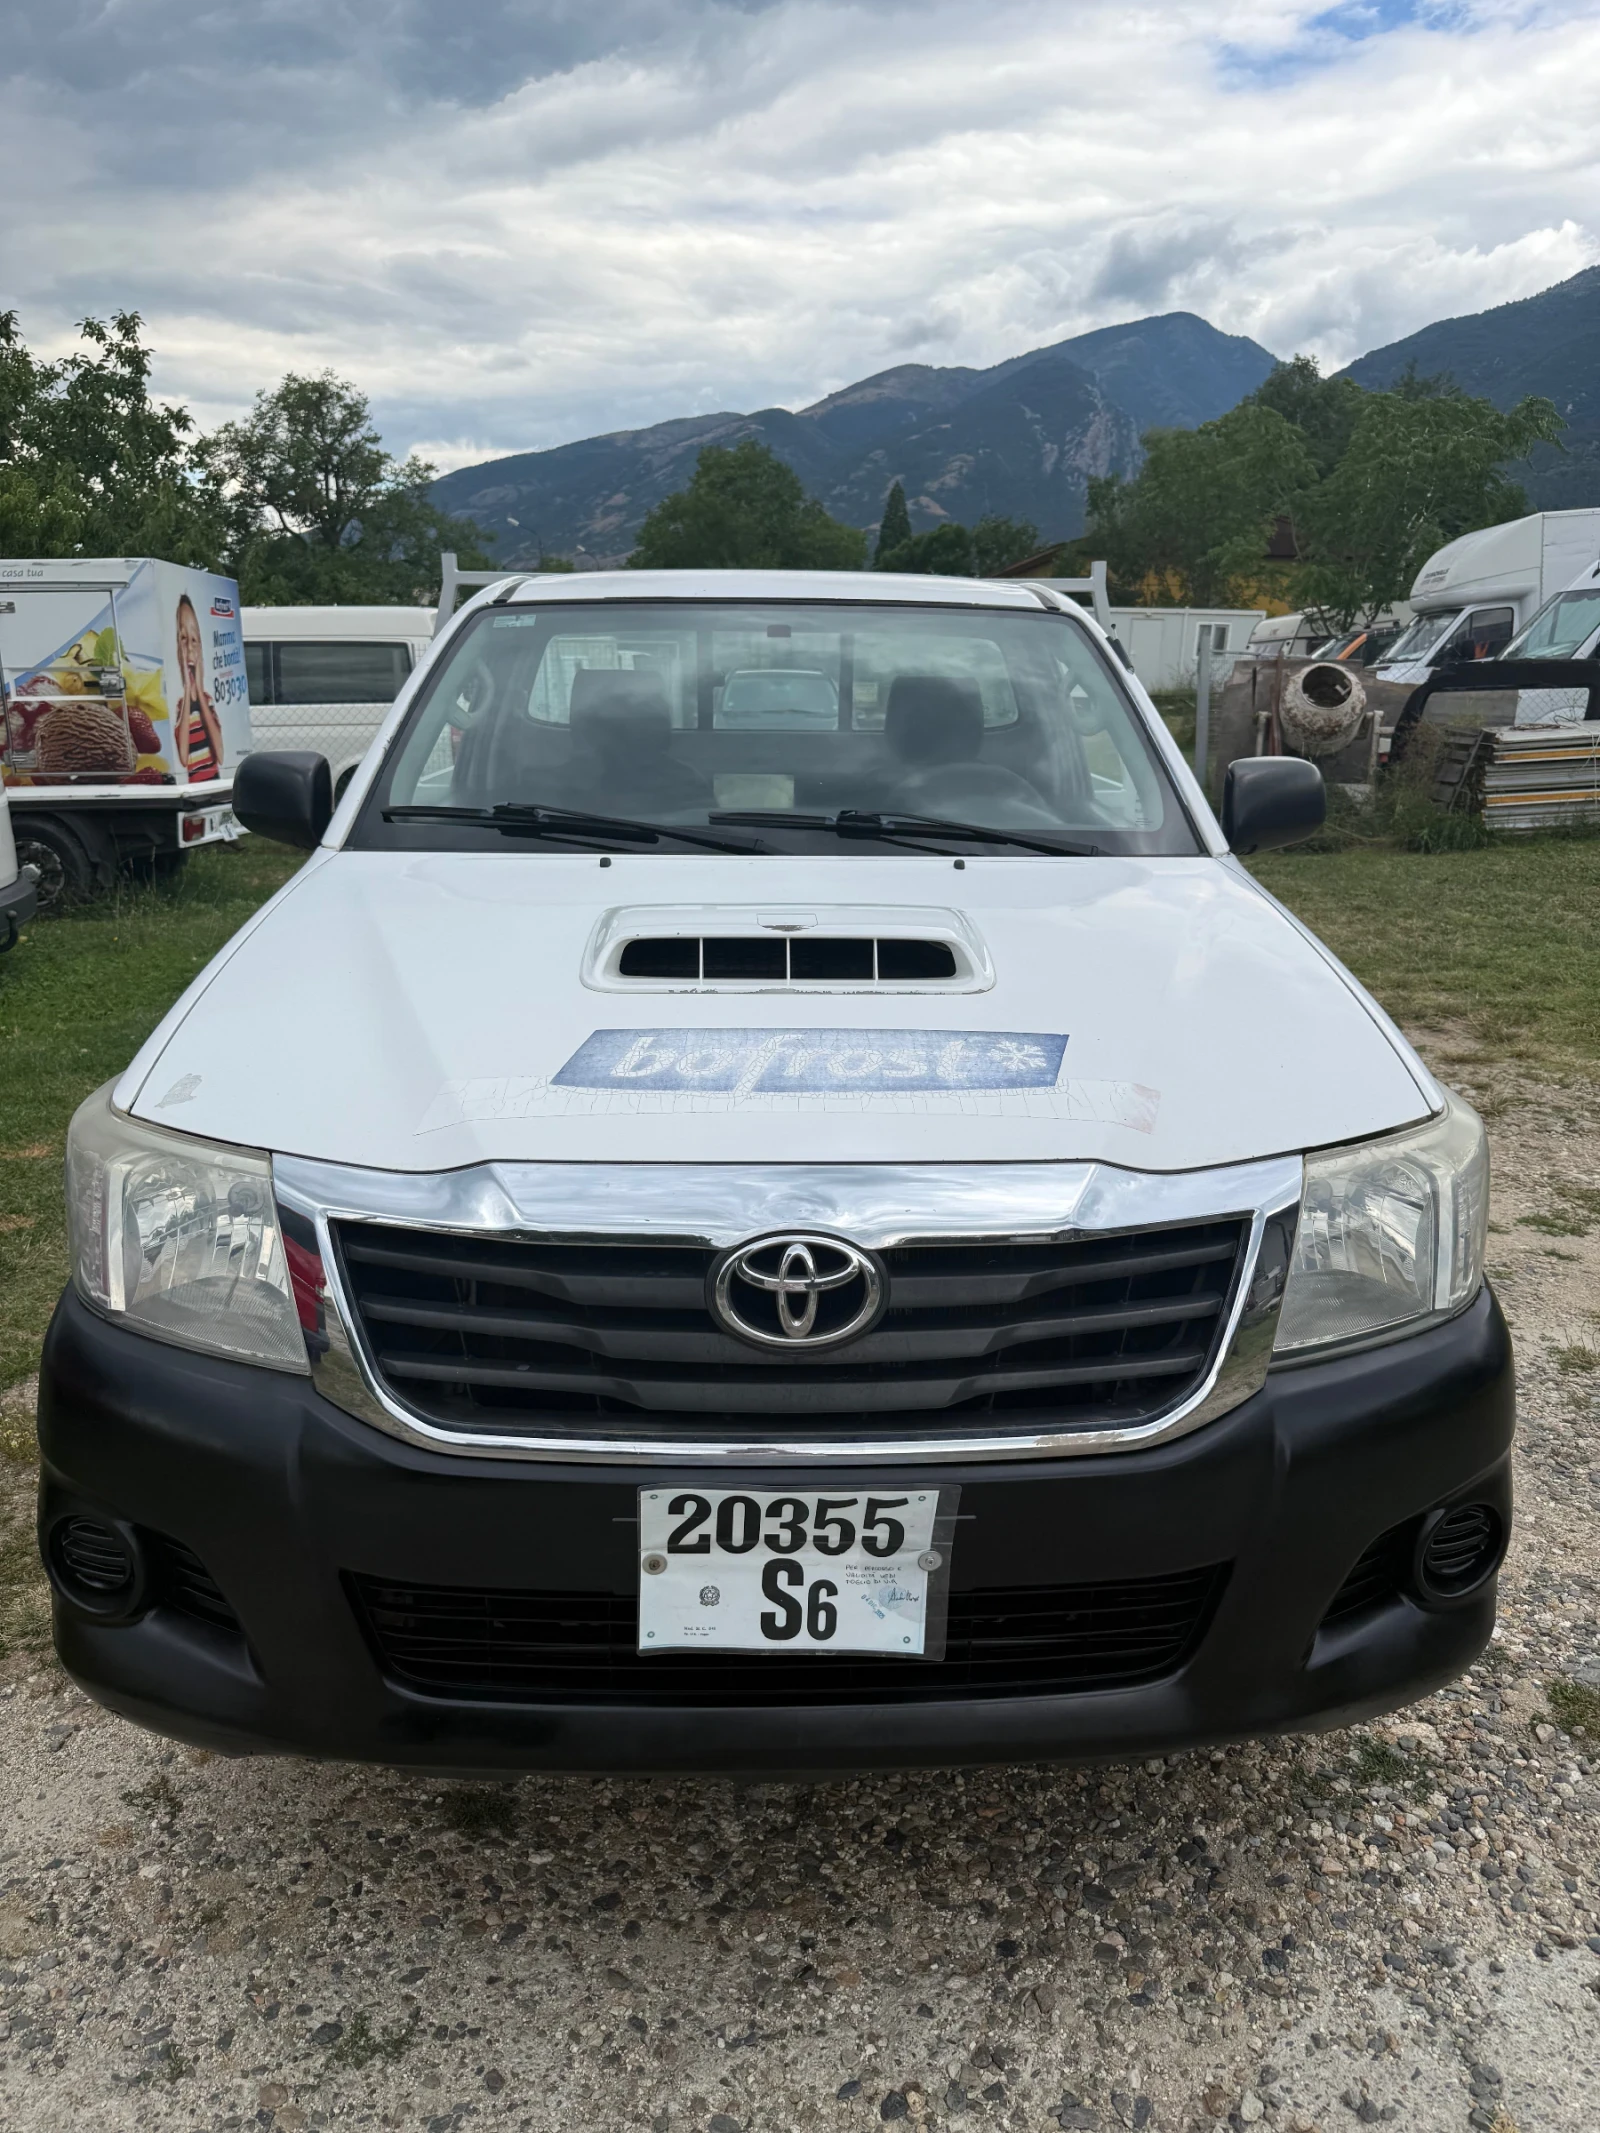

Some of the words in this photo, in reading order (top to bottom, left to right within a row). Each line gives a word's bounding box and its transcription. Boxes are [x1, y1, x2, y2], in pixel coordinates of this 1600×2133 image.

[2, 569, 24, 578] casa
[27, 568, 44, 578] tua
[214, 676, 246, 705] 803030
[667, 1493, 909, 1558] 20355
